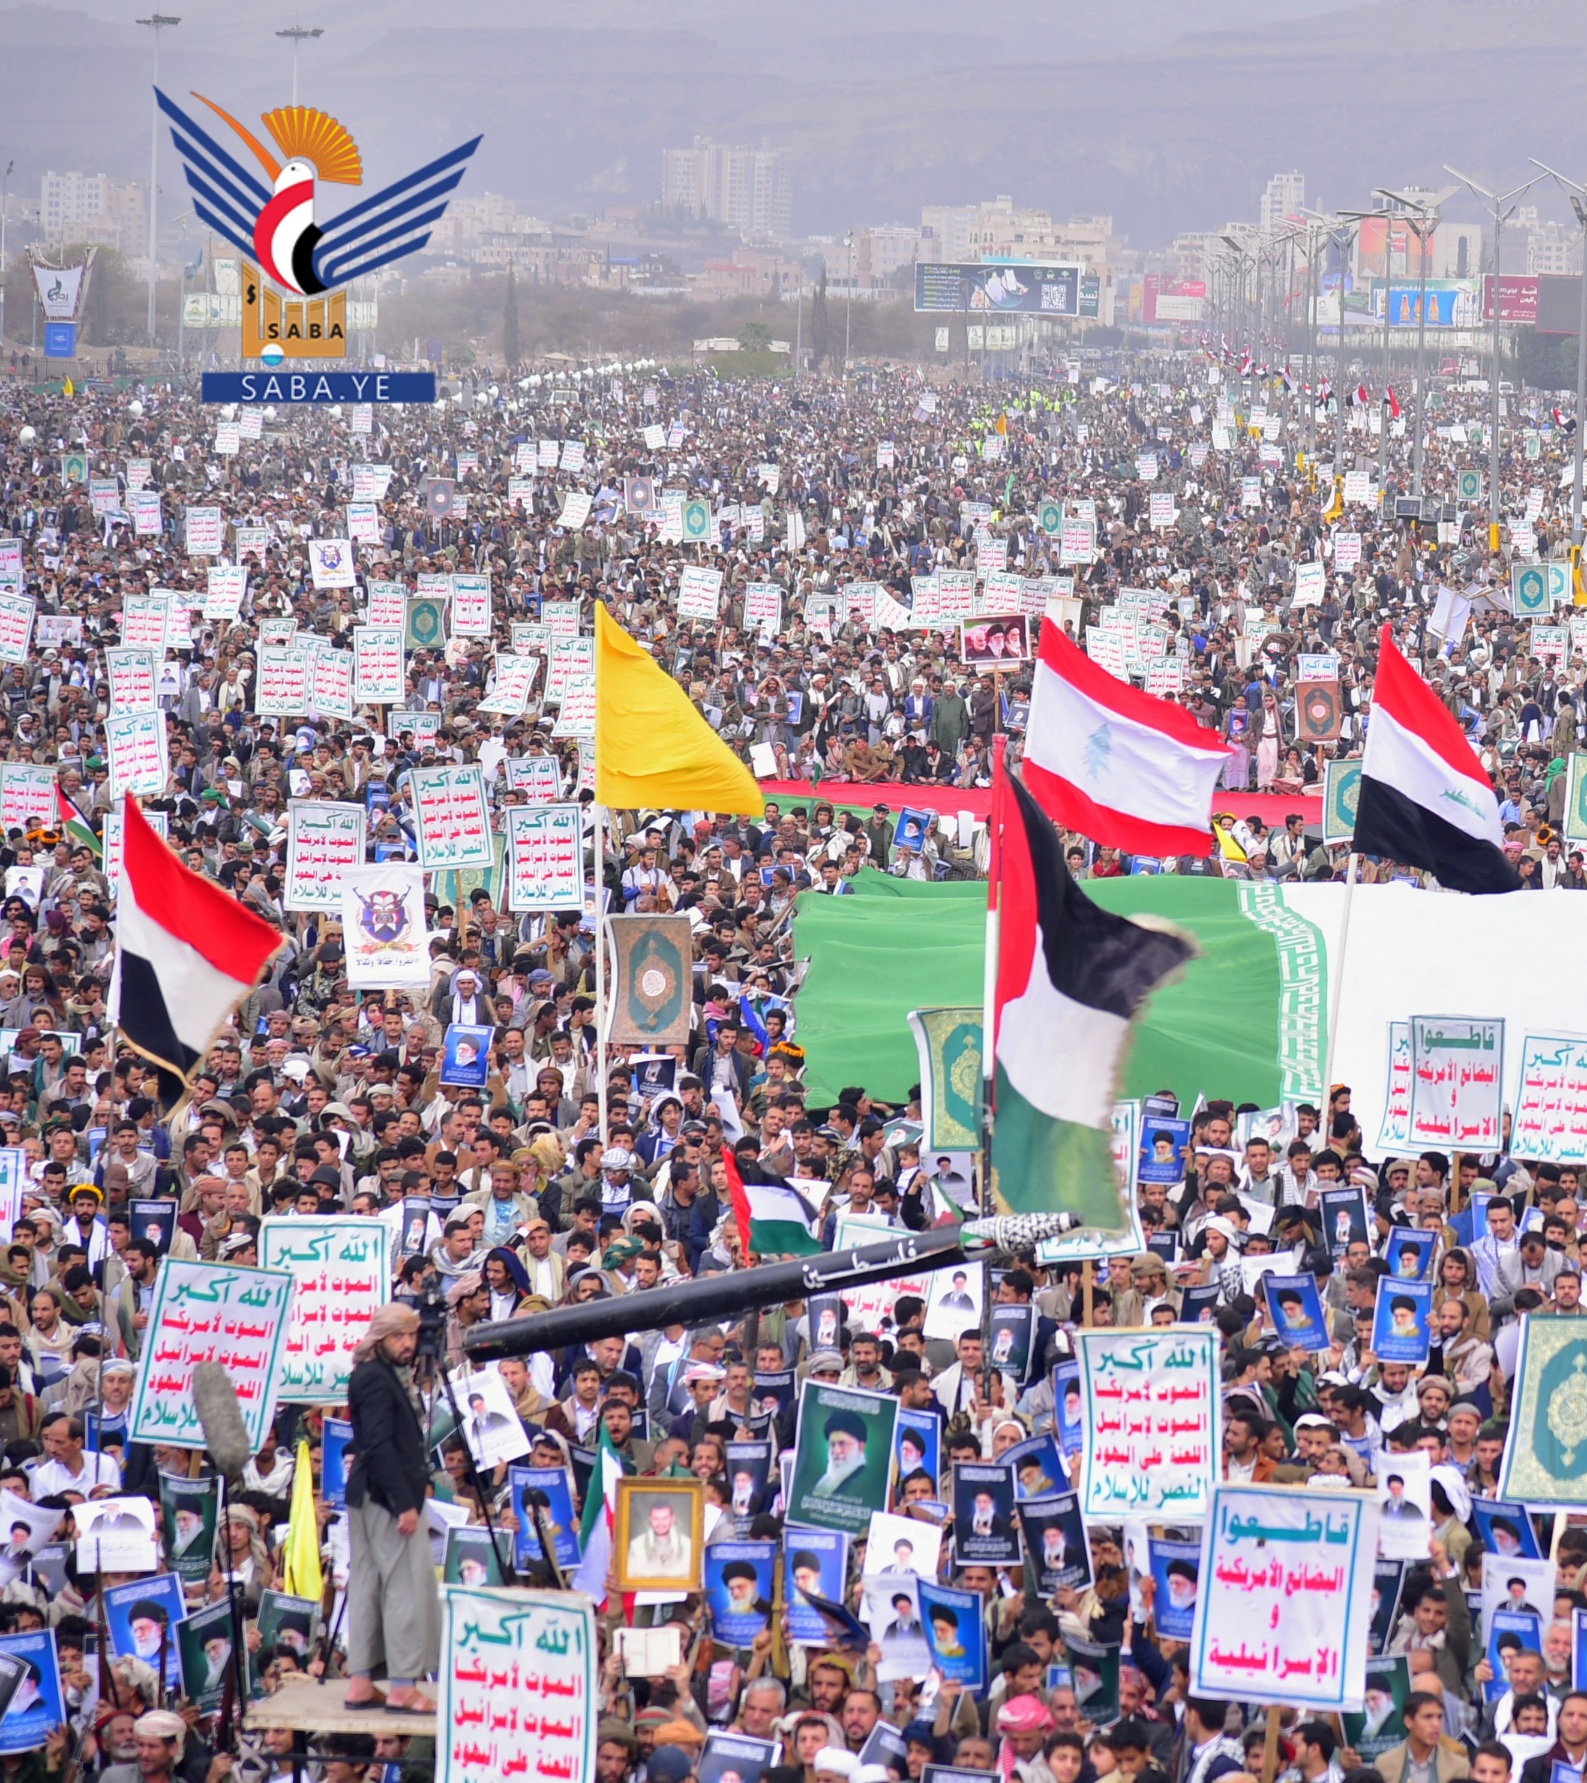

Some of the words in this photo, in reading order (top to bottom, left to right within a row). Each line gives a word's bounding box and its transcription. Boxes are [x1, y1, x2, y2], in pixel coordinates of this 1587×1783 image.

[516, 810, 551, 832] أكبر
[552, 812, 576, 828] الله
[515, 834, 547, 848] لأمريكا
[549, 834, 576, 847] الموت
[516, 852, 548, 865] لإسرائيل
[549, 850, 576, 864] الموت
[516, 869, 539, 882] اليهود
[541, 869, 554, 881] على
[556, 867, 576, 878] اللعنة
[516, 883, 547, 899] للإسلام
[549, 883, 577, 901] النصر
[1419, 1023, 1495, 1053] قاطعوا
[1527, 1044, 1574, 1070] أكبر
[1415, 1058, 1457, 1085] الأمريكية
[1460, 1063, 1498, 1088] البضائع
[1525, 1072, 1565, 1091] لأمريكا
[1450, 1087, 1457, 1108] و
[1521, 1095, 1562, 1113] لإسرائيل
[1414, 1111, 1497, 1142] الإسرائيلية
[1517, 1119, 1547, 1132] اليهود
[1548, 1120, 1566, 1135] على
[1511, 1133, 1555, 1159] للإسلام
[802, 1239, 917, 1290] فلسطين
[167, 1273, 237, 1304] أكبر
[237, 1284, 284, 1308] الله
[161, 1309, 222, 1336] لأمريكا
[224, 1320, 274, 1340] الموت
[154, 1341, 216, 1368] لإسرائيل
[216, 1350, 268, 1370] الموت
[1095, 1340, 1159, 1374] أكبر
[1163, 1343, 1207, 1369] الله
[148, 1371, 194, 1395] اليهود
[1094, 1379, 1151, 1404] لأمريكا
[1157, 1382, 1206, 1404] الموت
[1096, 1411, 1152, 1437] لإسرائيل
[1157, 1414, 1207, 1437] الموت
[1095, 1446, 1135, 1467] اليهود
[1139, 1448, 1163, 1471] على
[1170, 1446, 1207, 1465] اللعنة
[1092, 1474, 1150, 1509] للإسلام
[1155, 1473, 1208, 1511] النصر
[1221, 1505, 1349, 1548] قاطعوا
[1215, 1556, 1283, 1591] الأمريكية
[1284, 1565, 1344, 1596] البضائع
[1270, 1604, 1280, 1630] و
[458, 1610, 531, 1655] أكبر
[535, 1620, 582, 1656] الله
[1208, 1638, 1337, 1680] الإسرائيلية
[455, 1657, 519, 1690] لأمريكا
[525, 1675, 582, 1699] الموت
[454, 1698, 518, 1732] لإسرائيل
[523, 1717, 581, 1740] الموت
[453, 1740, 497, 1771] اليهود
[501, 1750, 528, 1777] على
[536, 1756, 579, 1779] اللعنة
